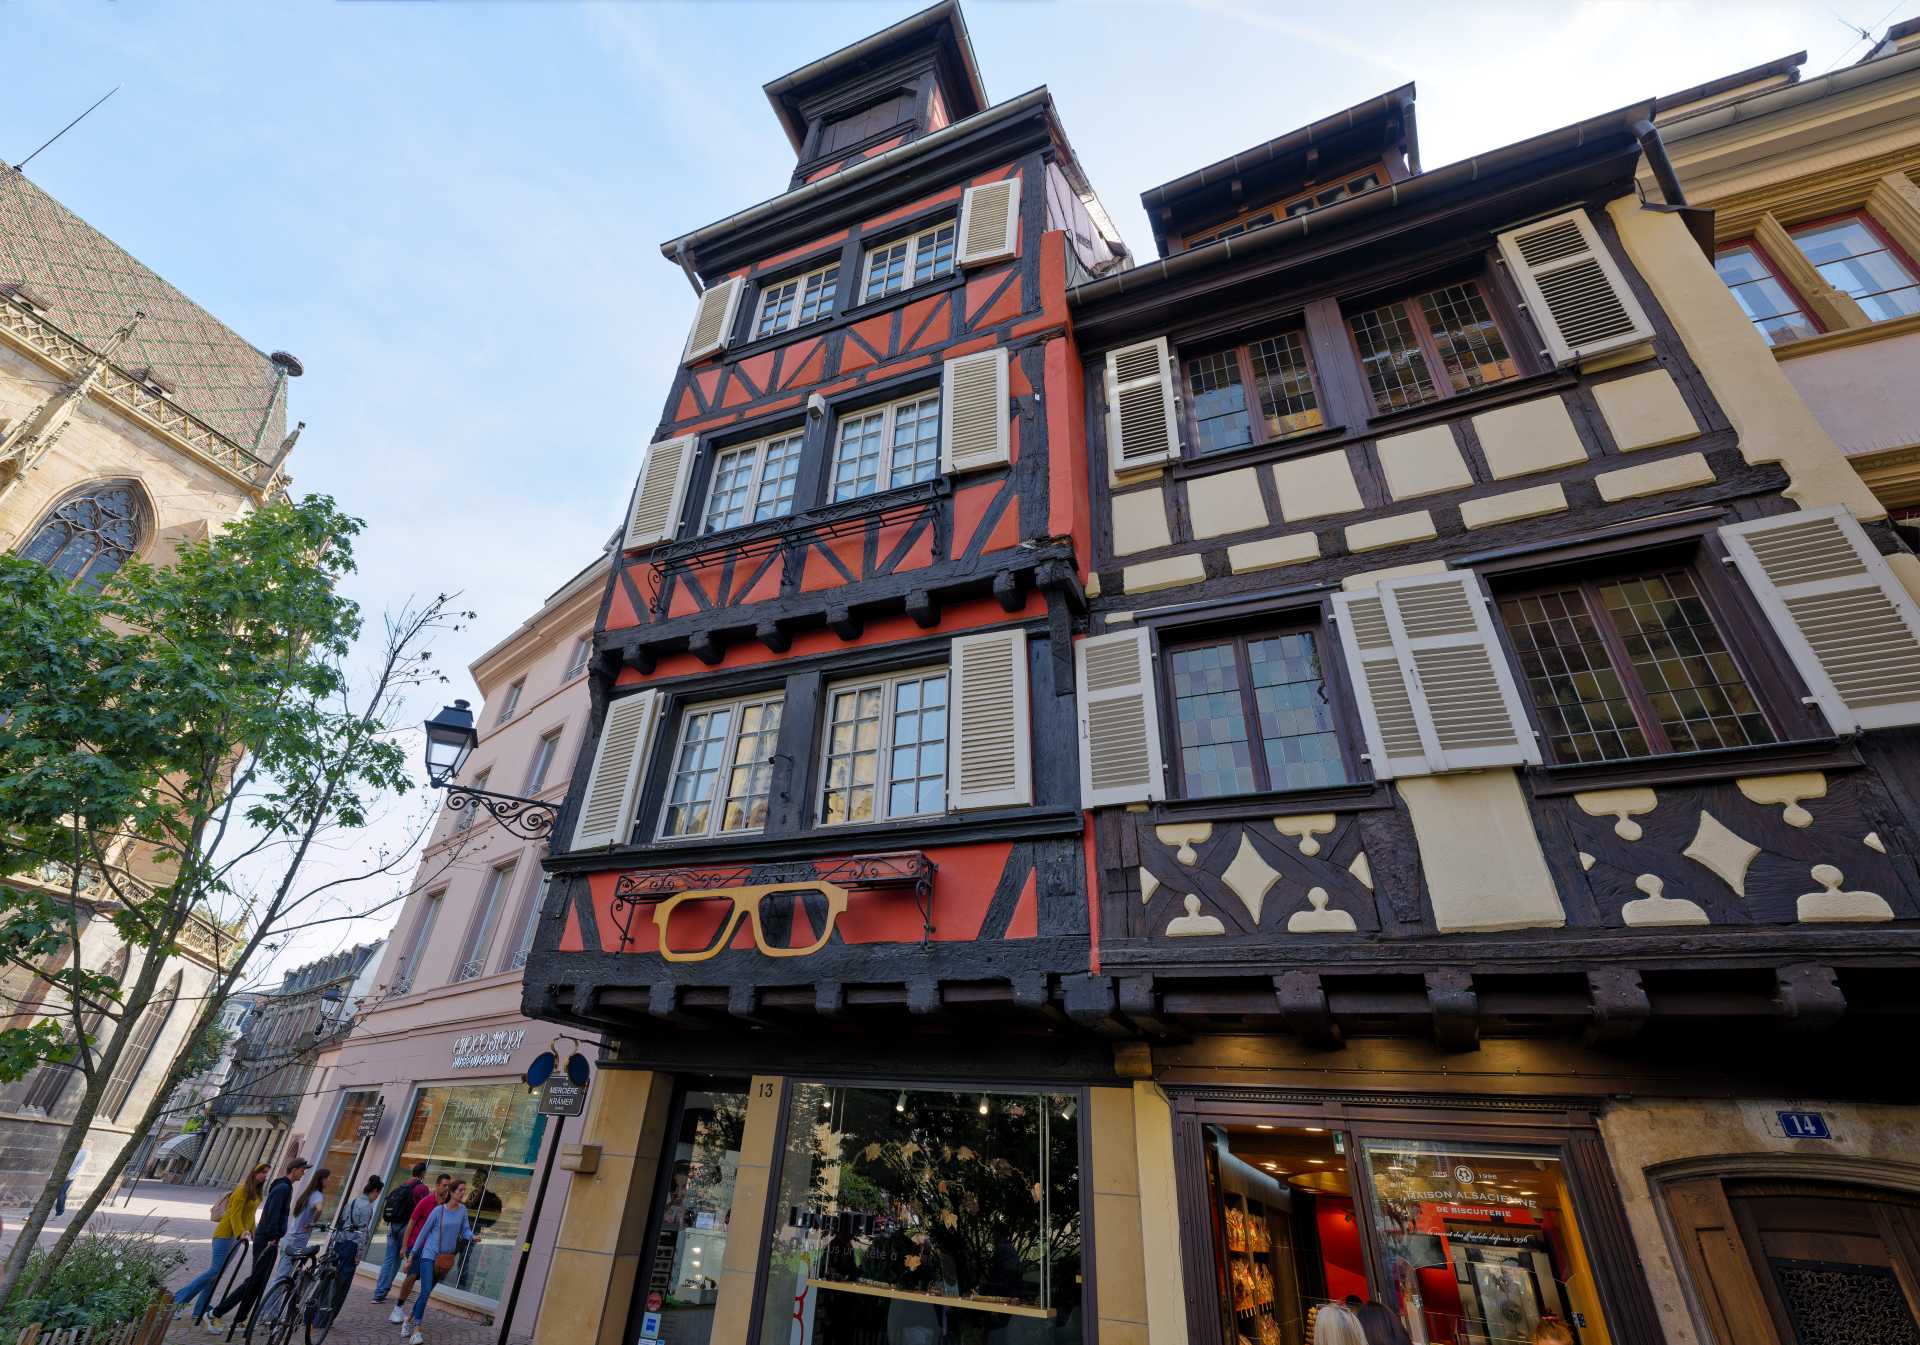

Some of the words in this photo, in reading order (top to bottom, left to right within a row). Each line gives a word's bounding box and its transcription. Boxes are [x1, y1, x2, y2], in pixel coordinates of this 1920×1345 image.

[489, 1028, 525, 1051] STORY
[758, 1083, 773, 1099] 13
[1790, 1115, 1817, 1135] 14
[1407, 1190, 1453, 1201] MAISON
[1436, 1205, 1449, 1213] DE
[1451, 1206, 1513, 1217] BISCUITERIE
[1488, 1234, 1511, 1245] depuis
